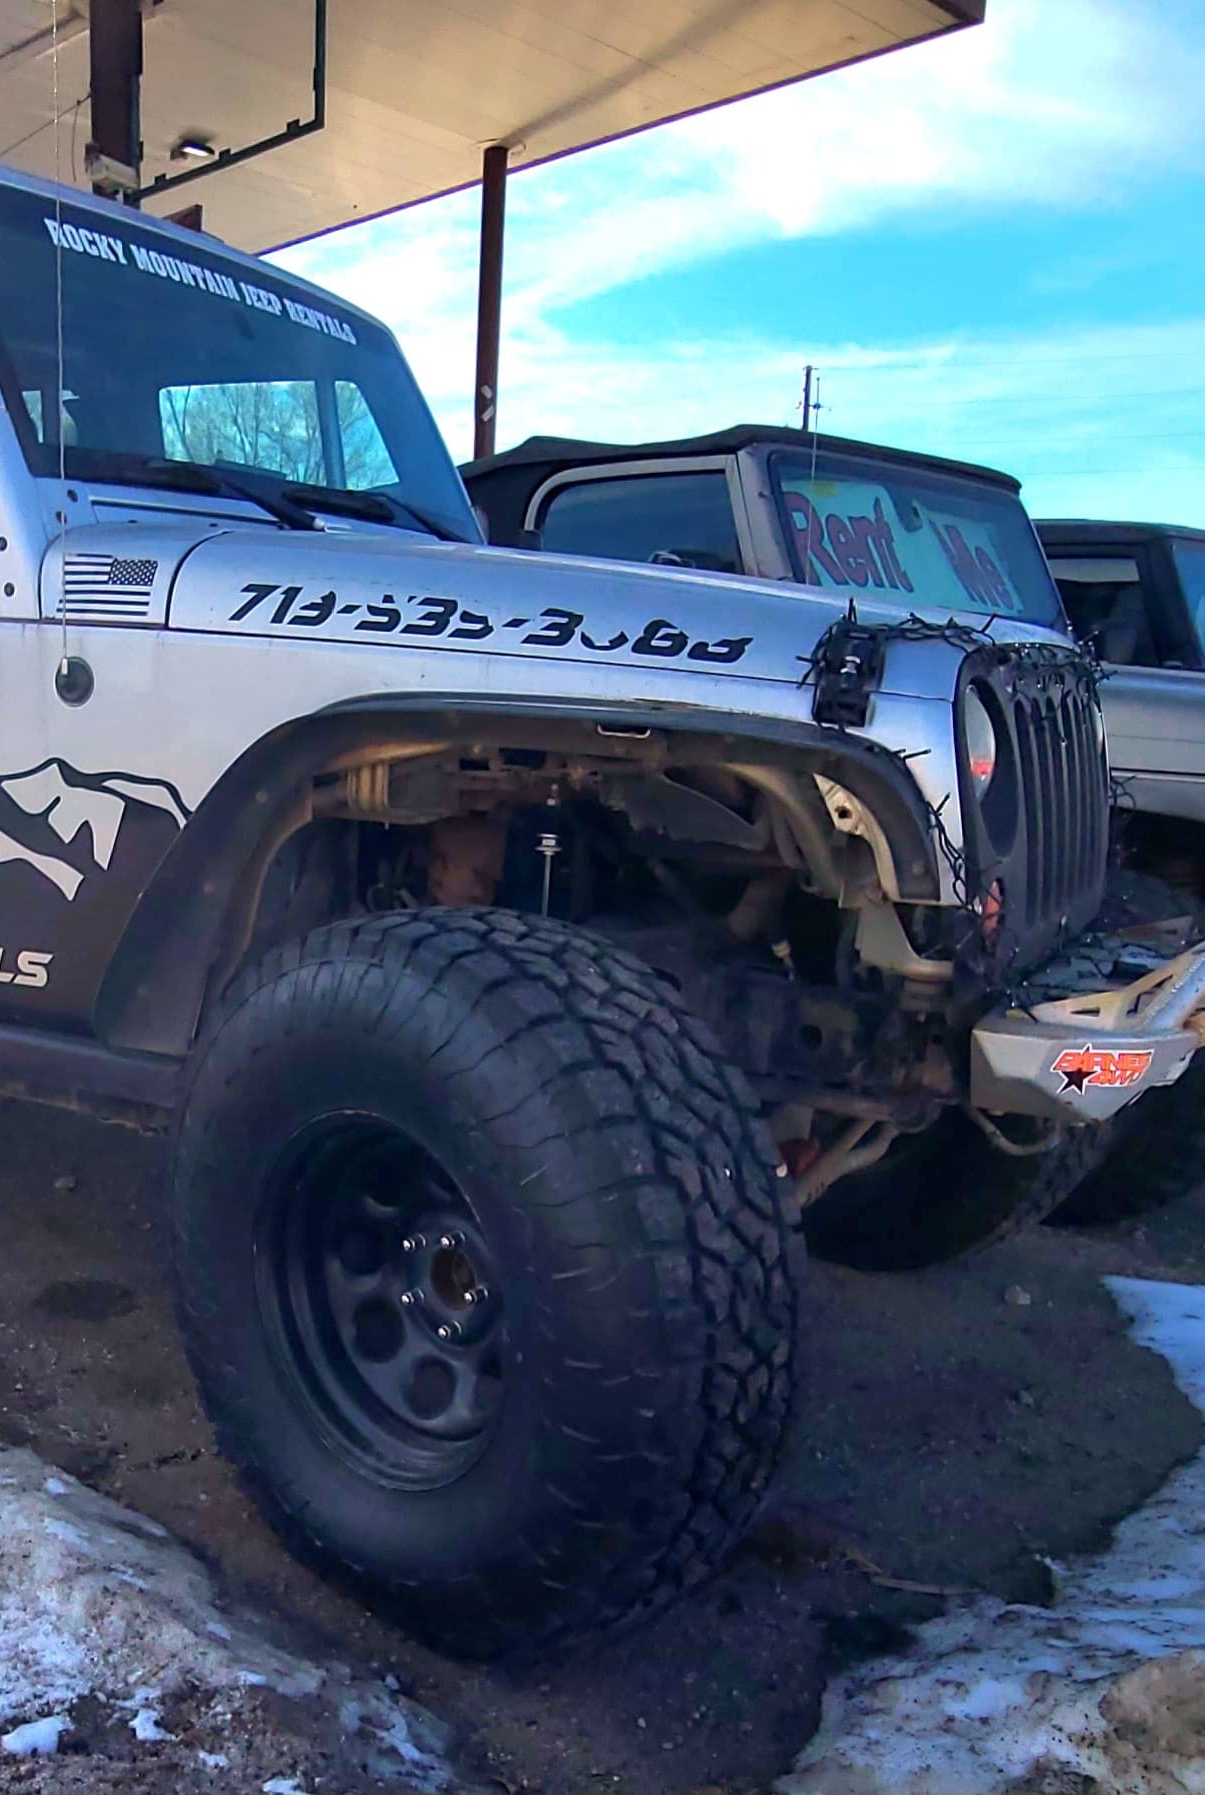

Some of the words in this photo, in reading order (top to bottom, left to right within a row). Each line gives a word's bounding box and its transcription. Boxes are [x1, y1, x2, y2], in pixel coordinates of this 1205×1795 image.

[44, 217, 128, 265] ROCKY
[130, 244, 241, 301] MOUNTAIN
[240, 282, 283, 316] JEEP
[283, 298, 357, 345] RENTALS
[783, 491, 914, 593] Rent
